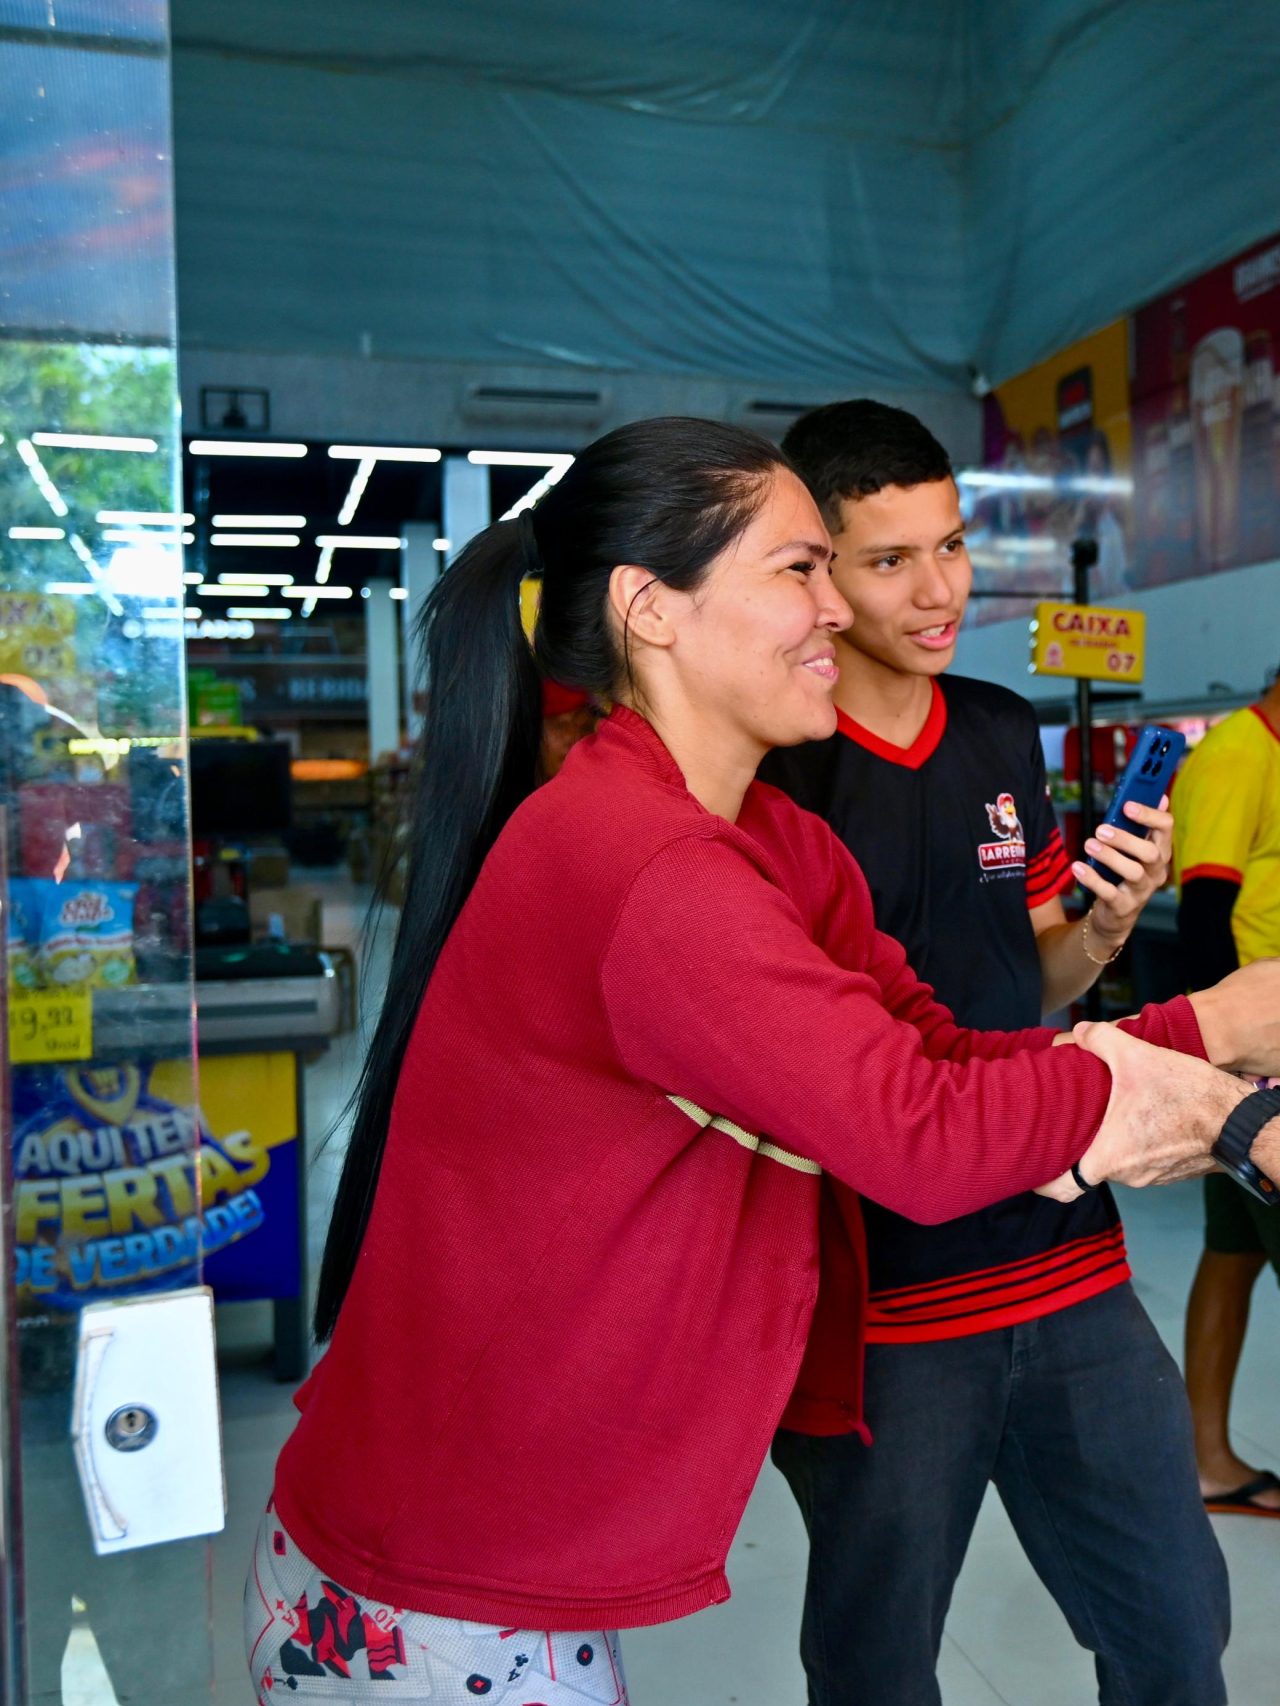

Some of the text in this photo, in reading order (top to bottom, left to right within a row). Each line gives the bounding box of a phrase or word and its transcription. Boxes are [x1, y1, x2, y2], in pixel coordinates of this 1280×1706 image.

[1052, 611, 1131, 637] CAIXA
[1107, 652, 1136, 673] 07
[17, 1126, 127, 1174] AQUI
[14, 1130, 270, 1243] FERTAS
[69, 1189, 263, 1286] VERDADE!
